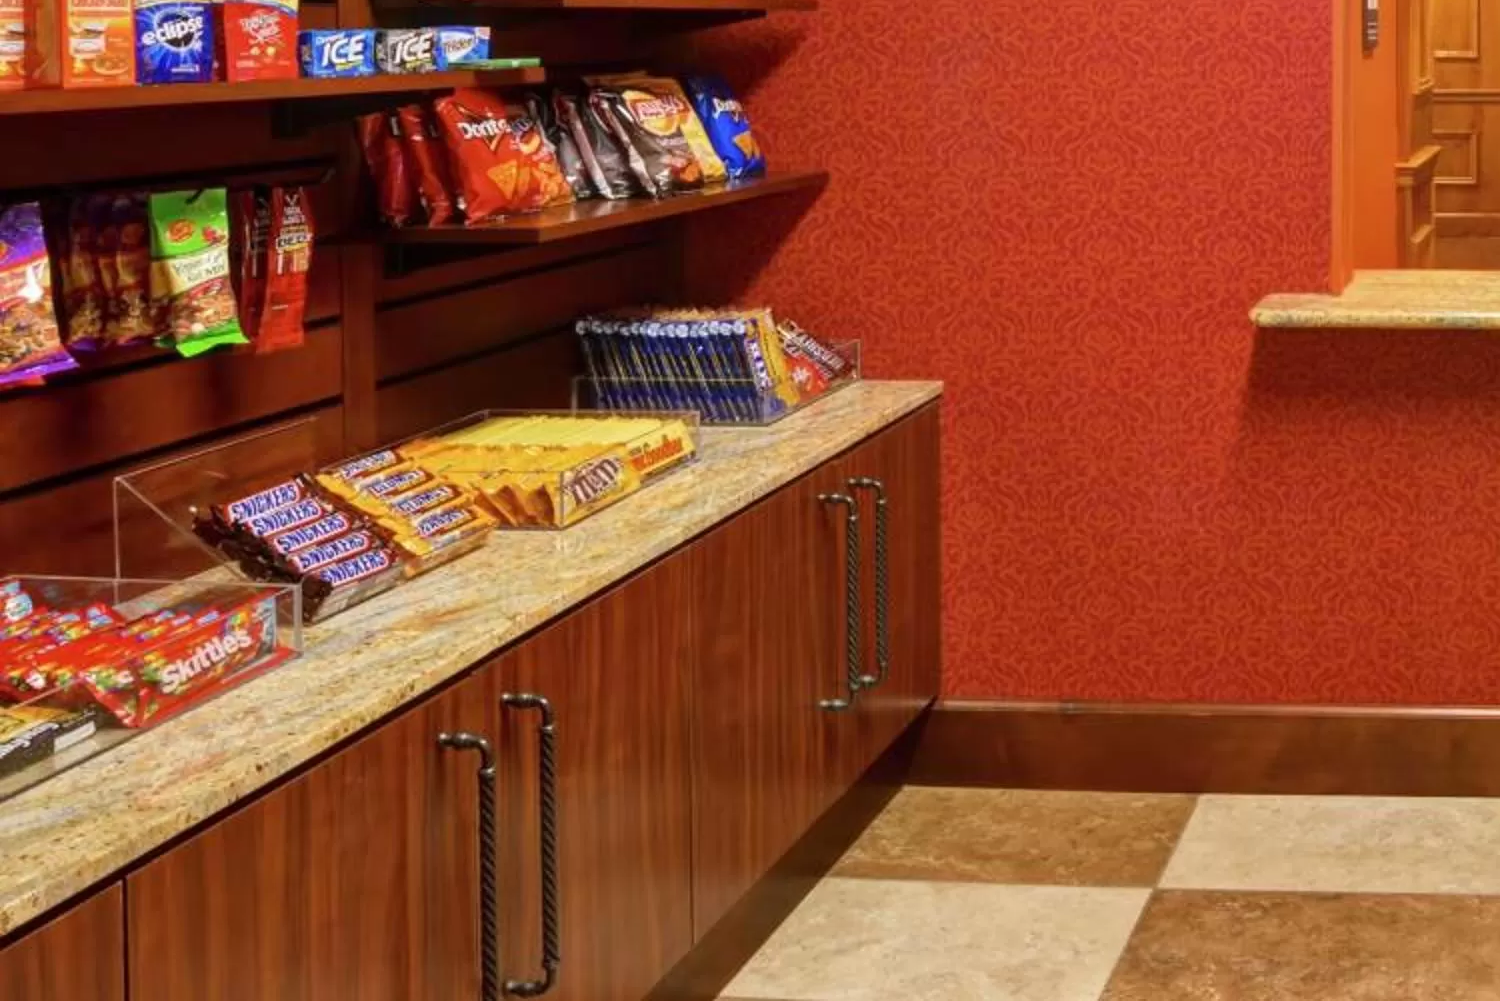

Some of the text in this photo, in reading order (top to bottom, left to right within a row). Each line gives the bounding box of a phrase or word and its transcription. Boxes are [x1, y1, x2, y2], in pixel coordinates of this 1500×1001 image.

[141, 16, 204, 46] eclipse
[394, 32, 431, 64] ICE
[322, 32, 365, 67] ICE
[231, 484, 297, 518] SNICKERS
[252, 500, 319, 536] SNICKERS
[277, 515, 345, 552] SNICKERS
[299, 533, 365, 569] SNICKERS
[319, 550, 387, 583] SNICKERS
[159, 629, 252, 694] Skittles
